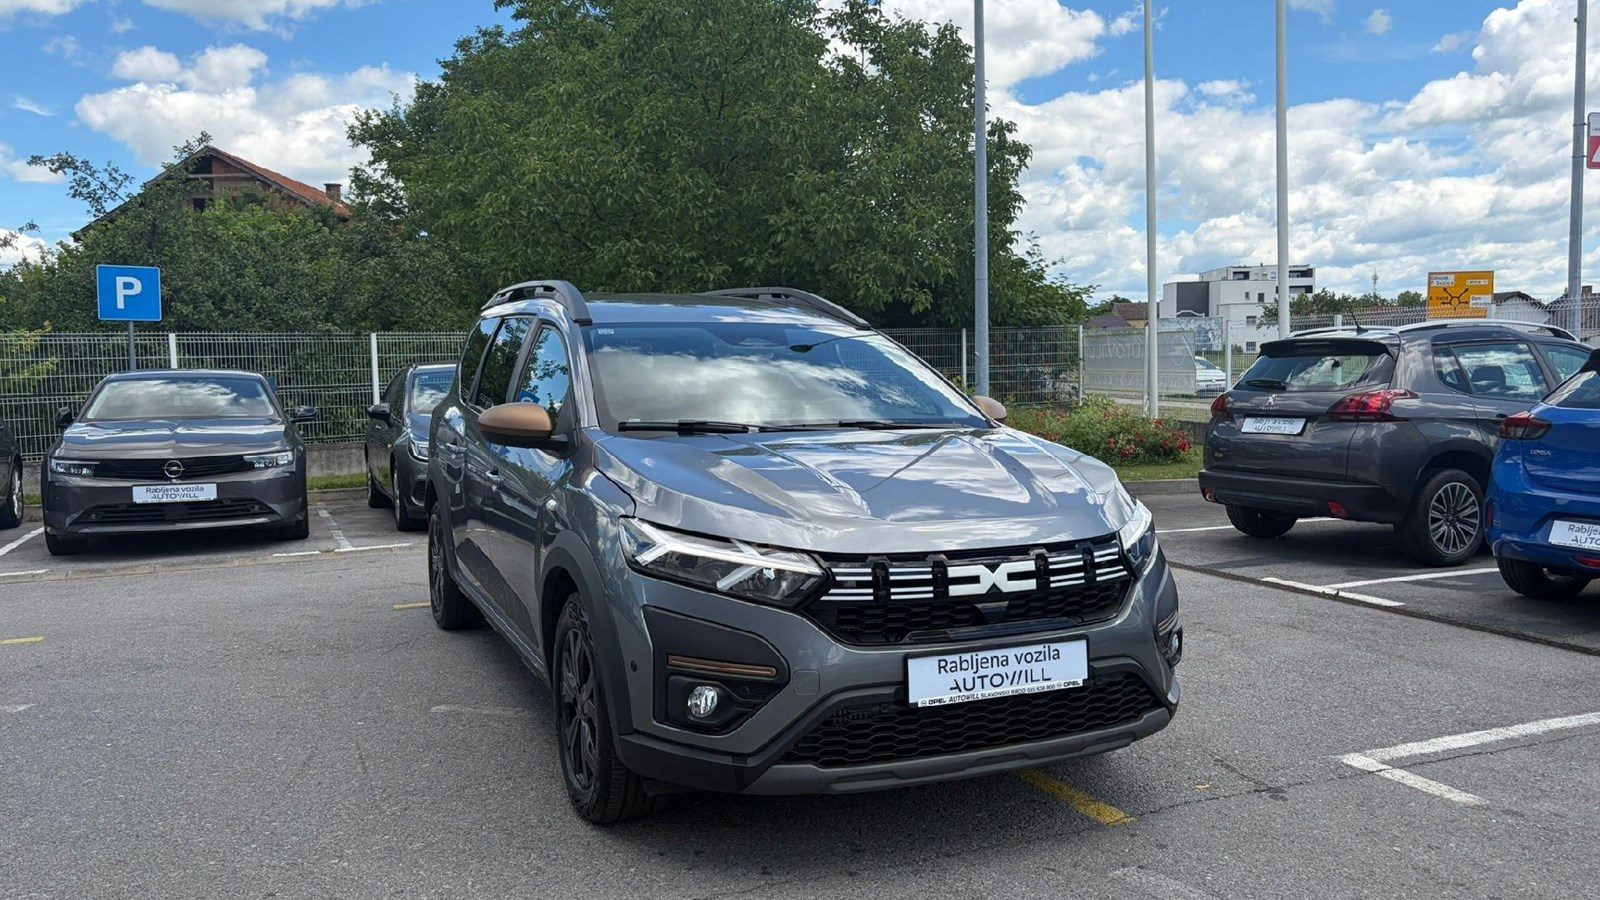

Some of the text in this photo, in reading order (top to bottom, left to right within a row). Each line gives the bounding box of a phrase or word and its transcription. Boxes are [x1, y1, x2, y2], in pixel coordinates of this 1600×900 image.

[116, 276, 142, 309] P
[146, 486, 180, 494] Rabljena
[1567, 524, 1600, 536] Rablje
[937, 645, 1060, 675] Rabljena vozila
